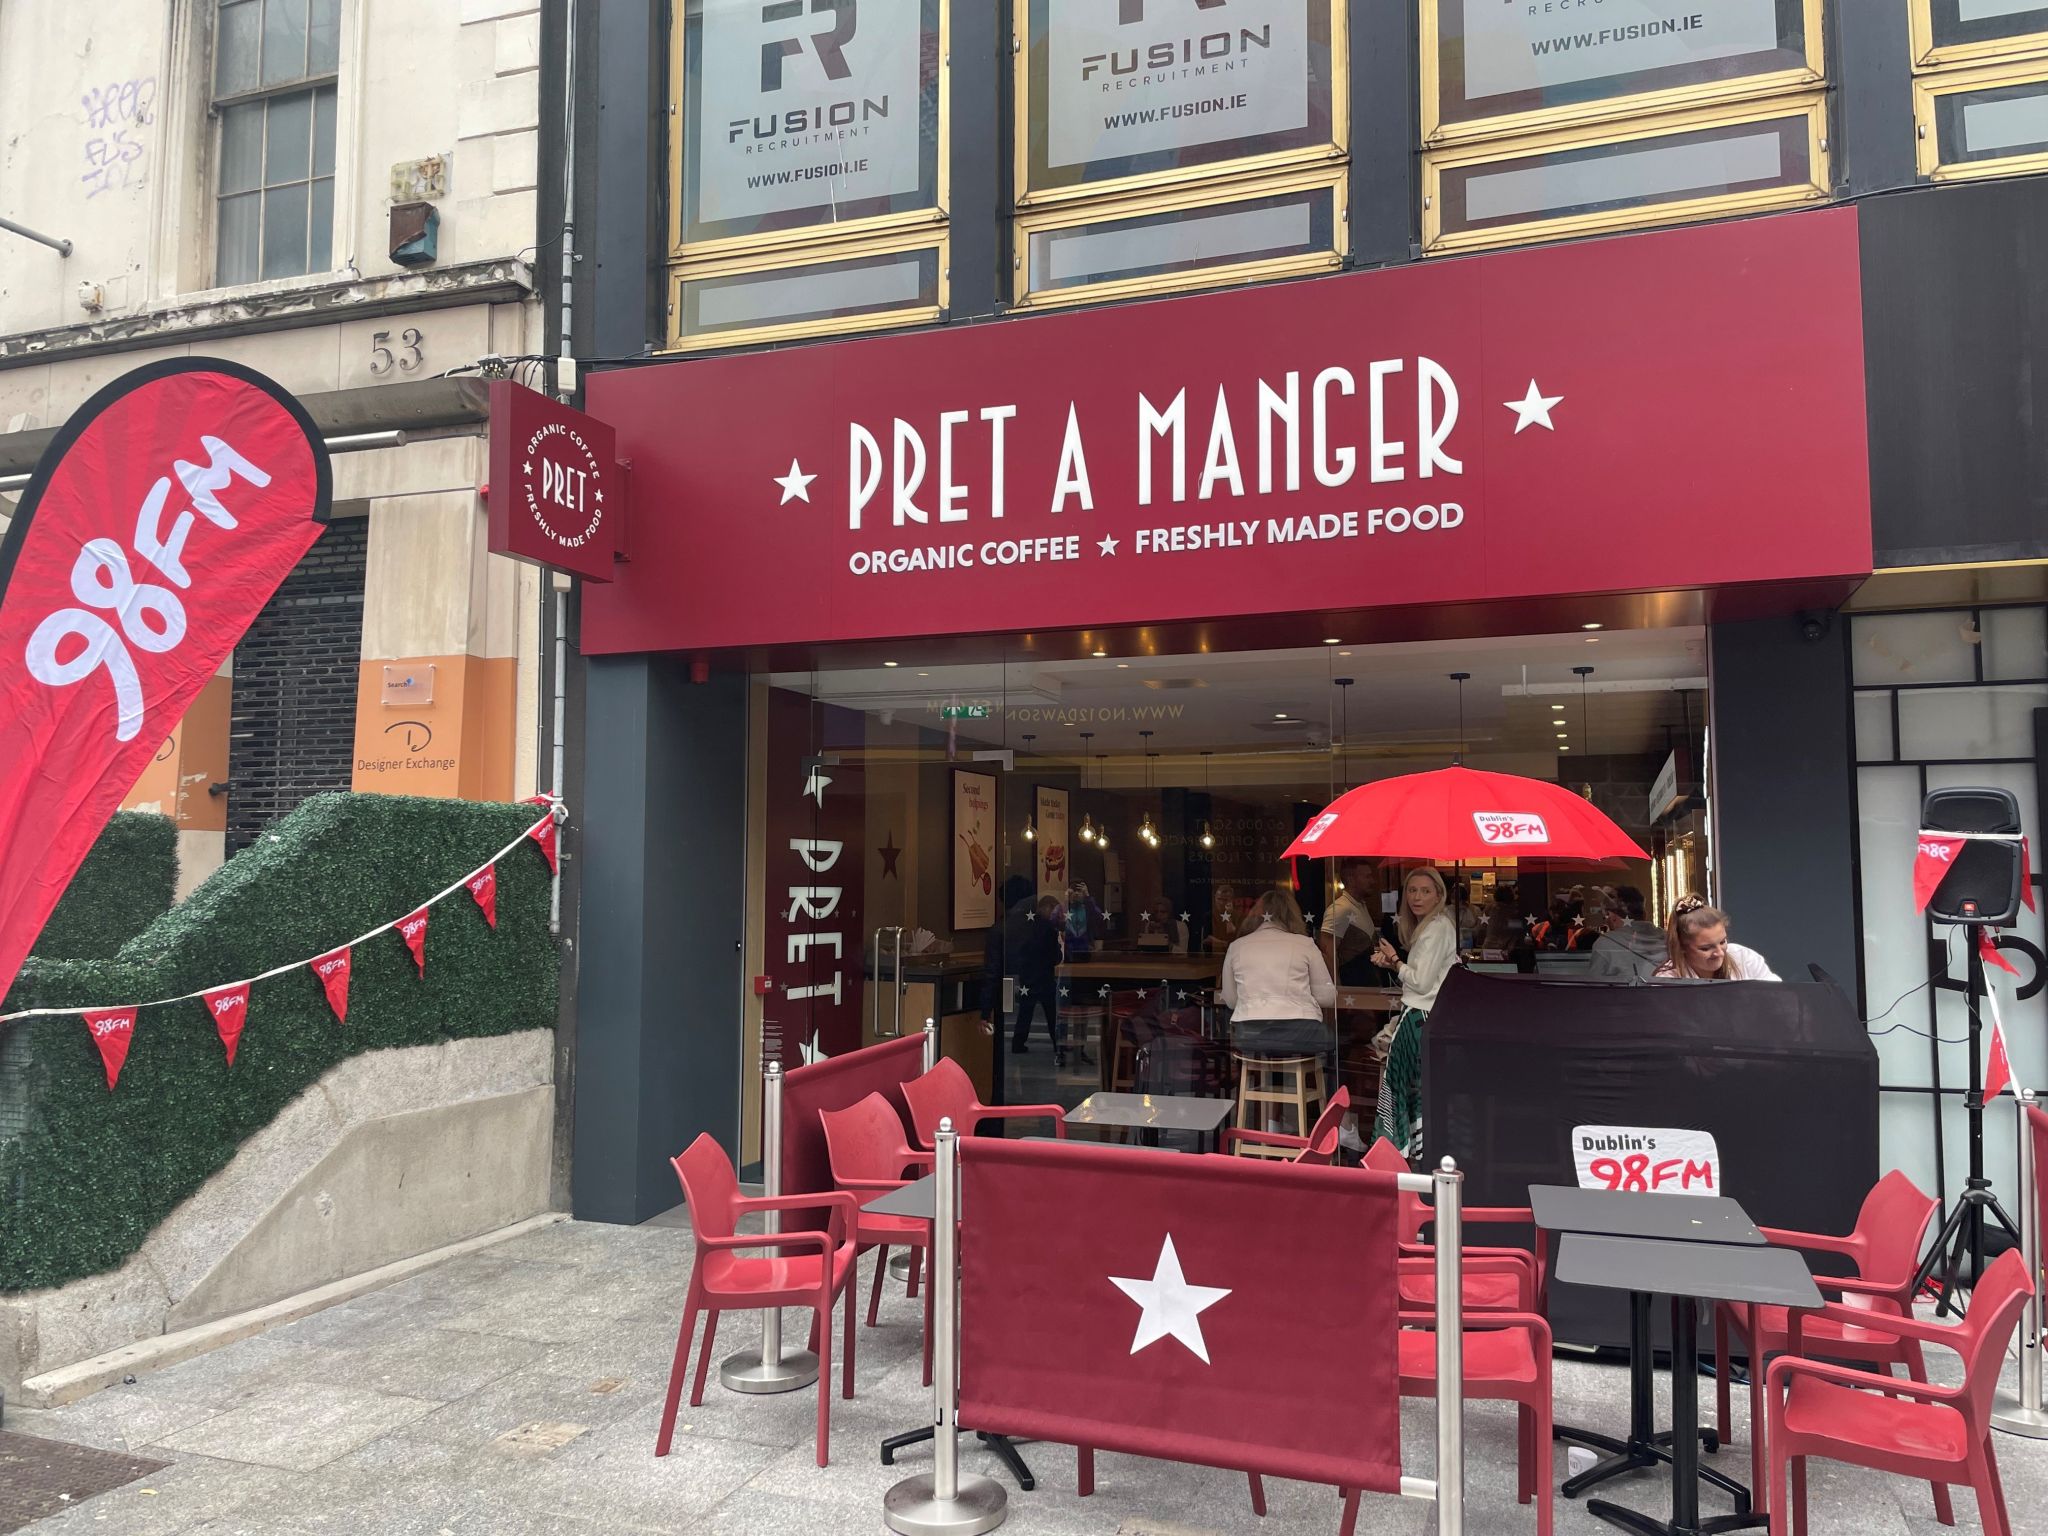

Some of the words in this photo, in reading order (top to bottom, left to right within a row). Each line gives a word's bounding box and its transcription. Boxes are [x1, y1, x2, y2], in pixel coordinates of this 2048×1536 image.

[1082, 24, 1270, 81] FUSION
[1531, 14, 1703, 56] WWW.FUSION.IE
[1102, 58, 1249, 92] RECRUITMENT
[729, 95, 888, 143] FUSION
[1104, 94, 1247, 129] WWW.FUSION.IE
[746, 126, 870, 154] RECRUITMENT
[747, 159, 868, 188] WWW.FUSION.IE
[370, 328, 423, 374] 53
[527, 424, 566, 455] ORGANIC
[570, 431, 600, 479] COFFEE
[850, 404, 1016, 530] PRET
[1051, 400, 1094, 513] A
[1139, 356, 1462, 505] MANGER
[543, 457, 587, 512] PRET
[525, 484, 557, 540] FRESHLY
[559, 535, 585, 547] MADE
[585, 509, 602, 539] FOOD
[849, 544, 973, 575] ORGANIC
[980, 536, 1080, 565] COFFEE
[1136, 520, 1260, 554] FRESHLY
[1267, 512, 1358, 543] MADE
[1368, 503, 1464, 534] FOOD
[25, 435, 272, 742] 98FM
[358, 759, 404, 772] Designer
[406, 757, 456, 771] Exchange
[1484, 822, 1544, 841] 98FM
[402, 918, 427, 939] 98FM
[786, 838, 844, 1006] PRET
[319, 959, 346, 978] 98FM
[215, 995, 245, 1016] 98FM
[95, 1018, 130, 1036] 98FM
[1582, 1134, 1656, 1151] Dublin's
[1590, 1153, 1713, 1194] 98FM
